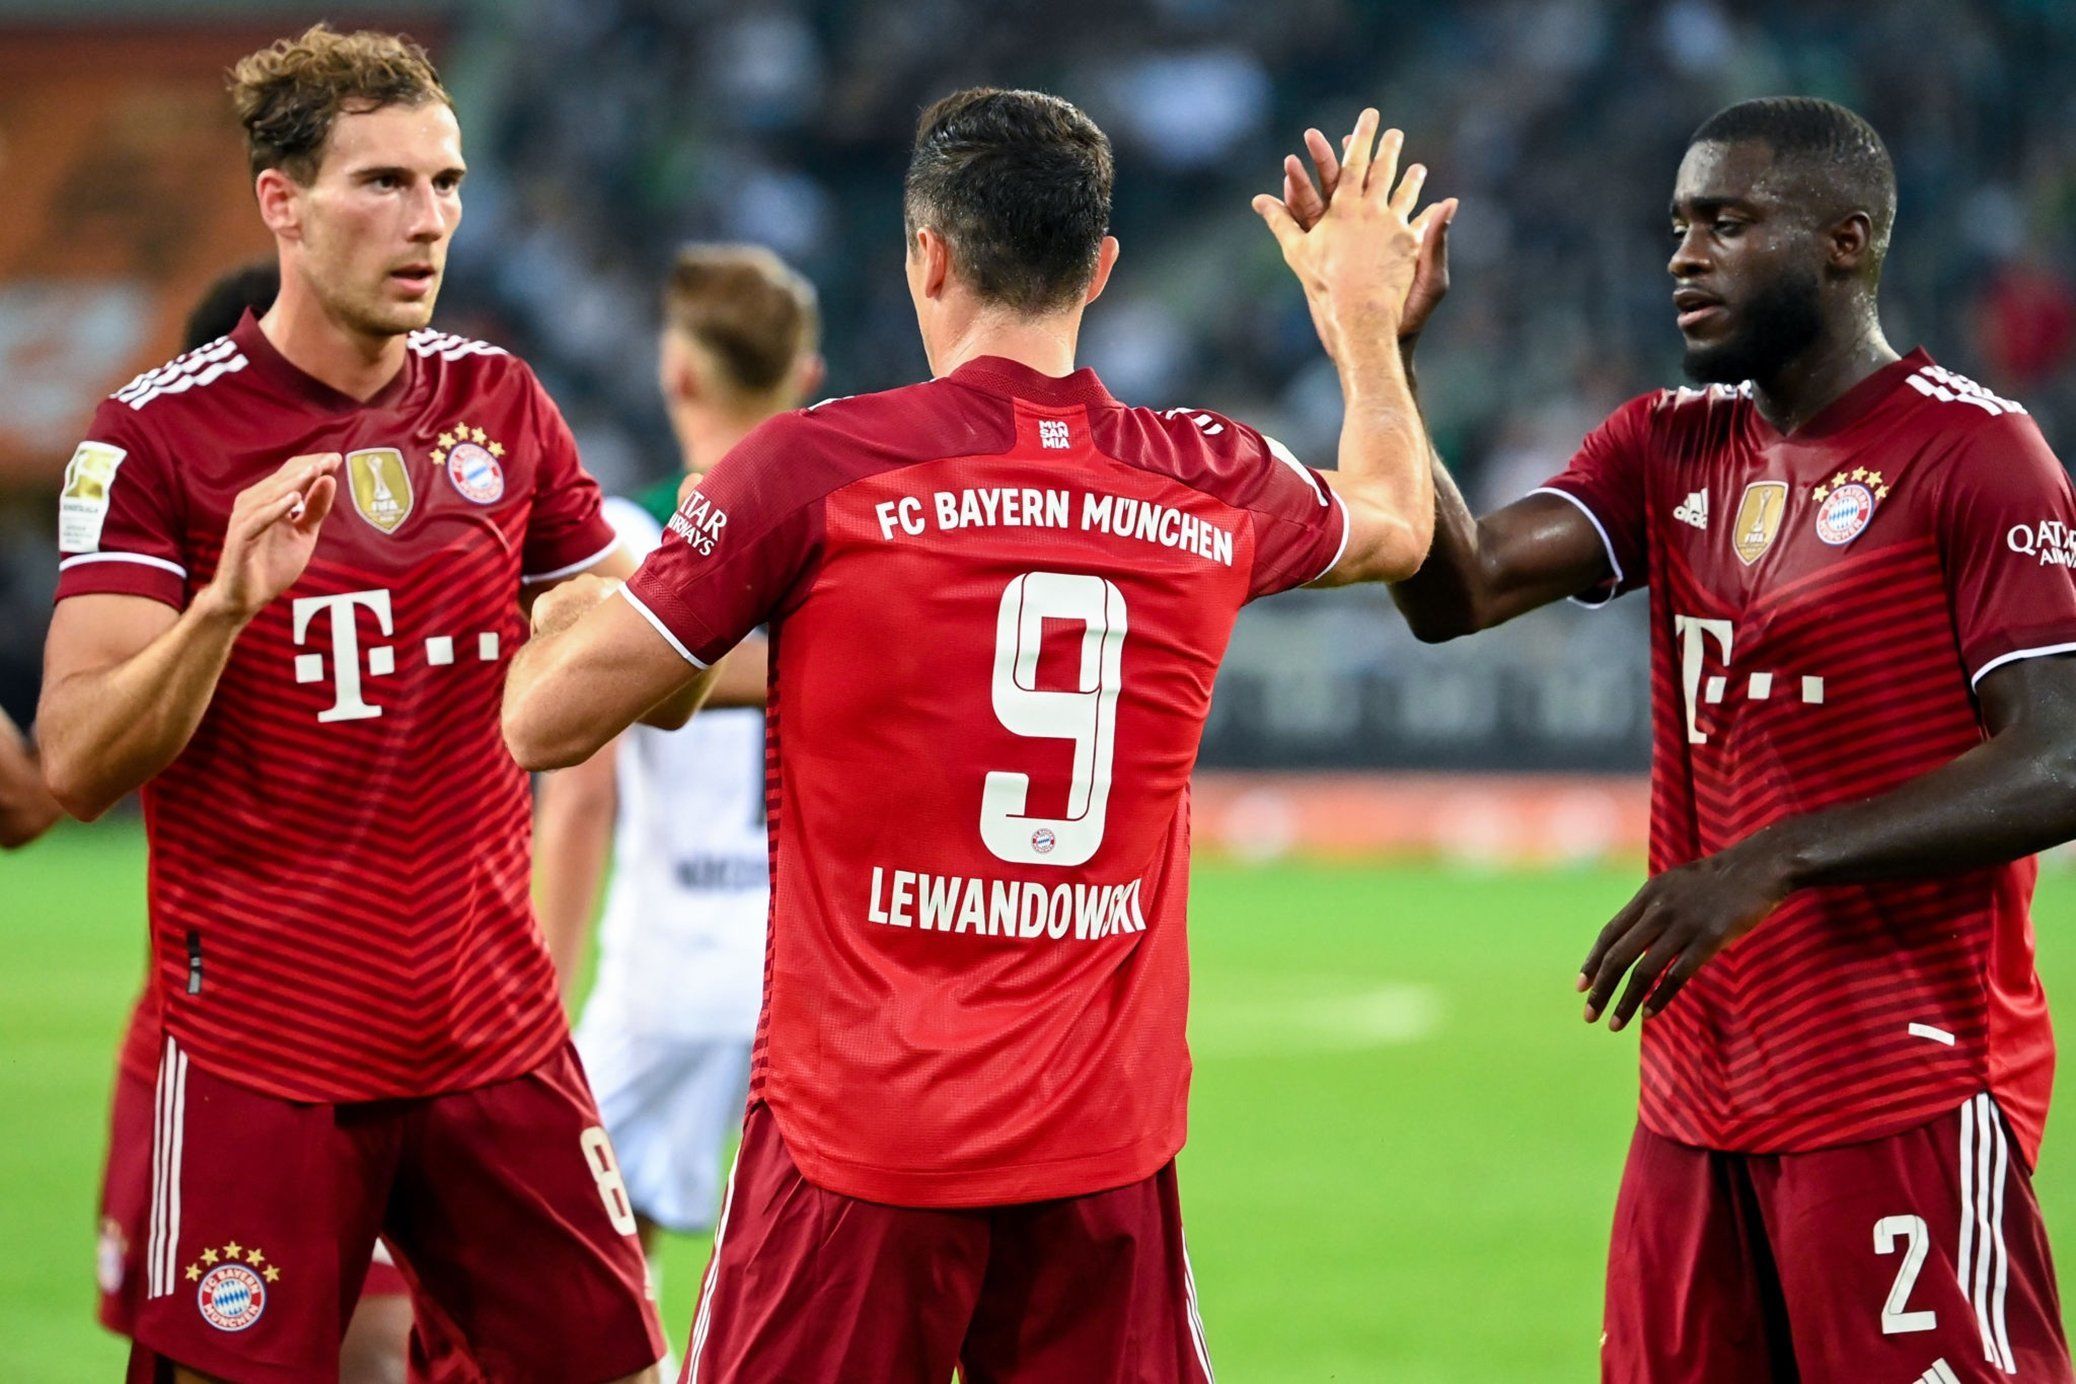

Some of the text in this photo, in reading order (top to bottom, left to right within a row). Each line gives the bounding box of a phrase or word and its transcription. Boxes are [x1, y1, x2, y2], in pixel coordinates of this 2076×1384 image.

[1040, 428, 1069, 438] SAN
[1042, 437, 1071, 449] MIA
[679, 490, 728, 541] TAR
[875, 488, 1233, 567] FC BAYERN MÜNCHEN
[979, 571, 1128, 866] 9
[868, 866, 1147, 940] LEWANDOWSKI
[580, 1126, 638, 1236] 8
[217, 1267, 261, 1294] BAYERN
[1873, 1214, 1937, 1335] 2
[203, 1303, 260, 1328] MÜNCHEN
